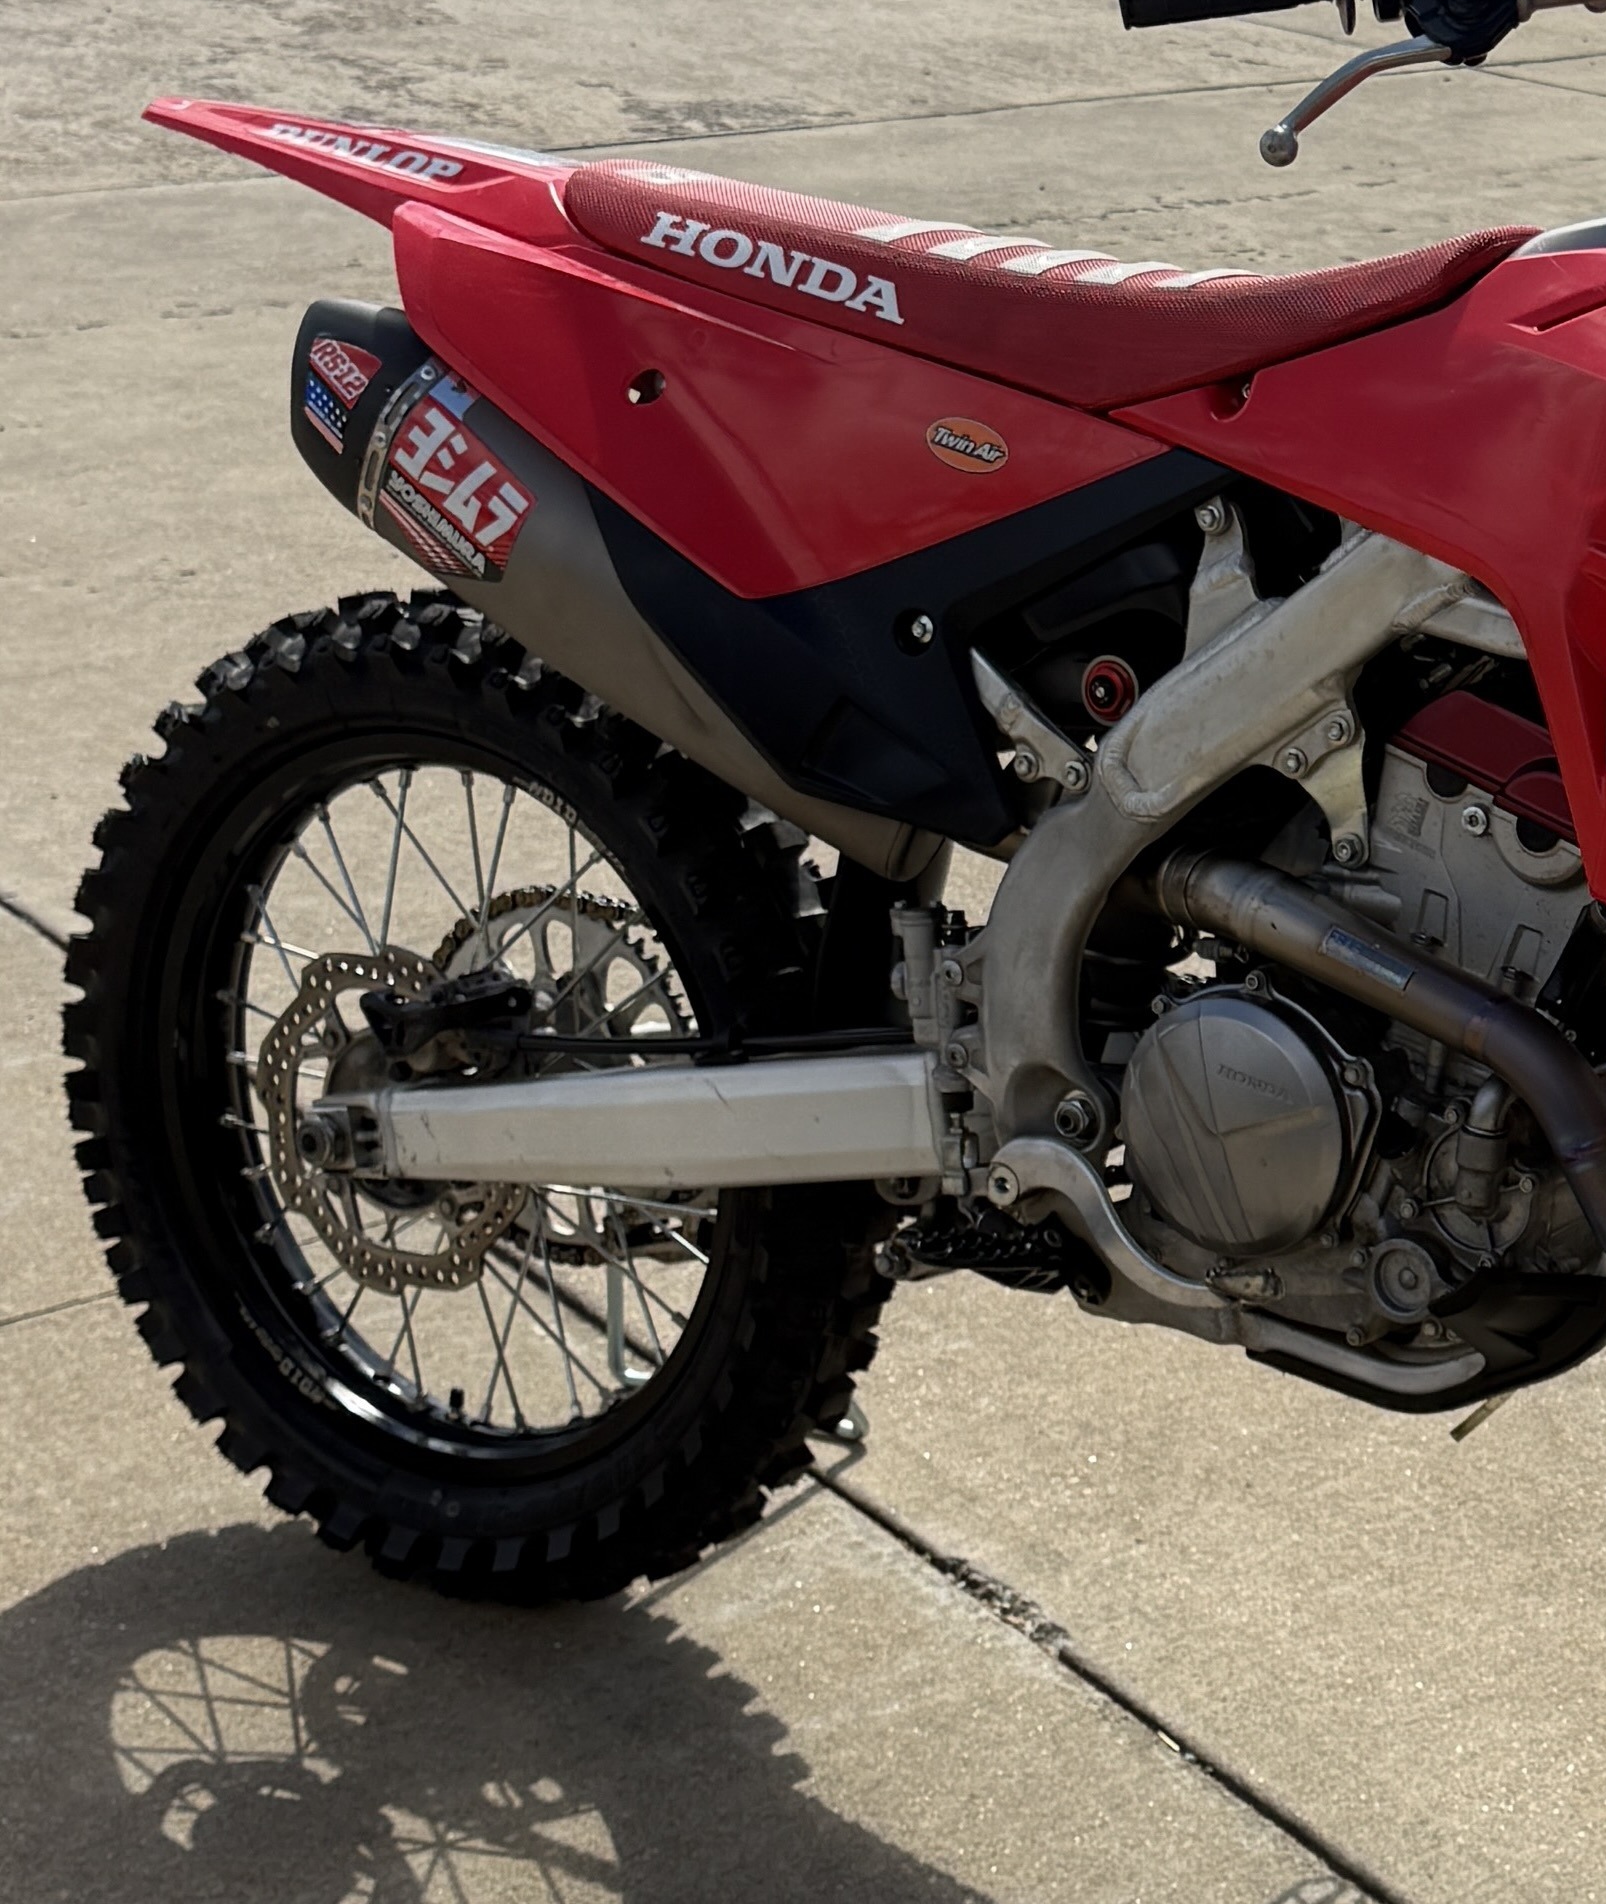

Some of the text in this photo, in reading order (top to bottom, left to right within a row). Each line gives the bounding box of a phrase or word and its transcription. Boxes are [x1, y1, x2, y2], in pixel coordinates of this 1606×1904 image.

[271, 123, 464, 179] DUNLOP
[640, 211, 905, 325] HONDA
[933, 426, 1005, 462] Twin Air
[387, 470, 486, 575] YOSHIMURA
[1216, 1063, 1295, 1105] HONDA
